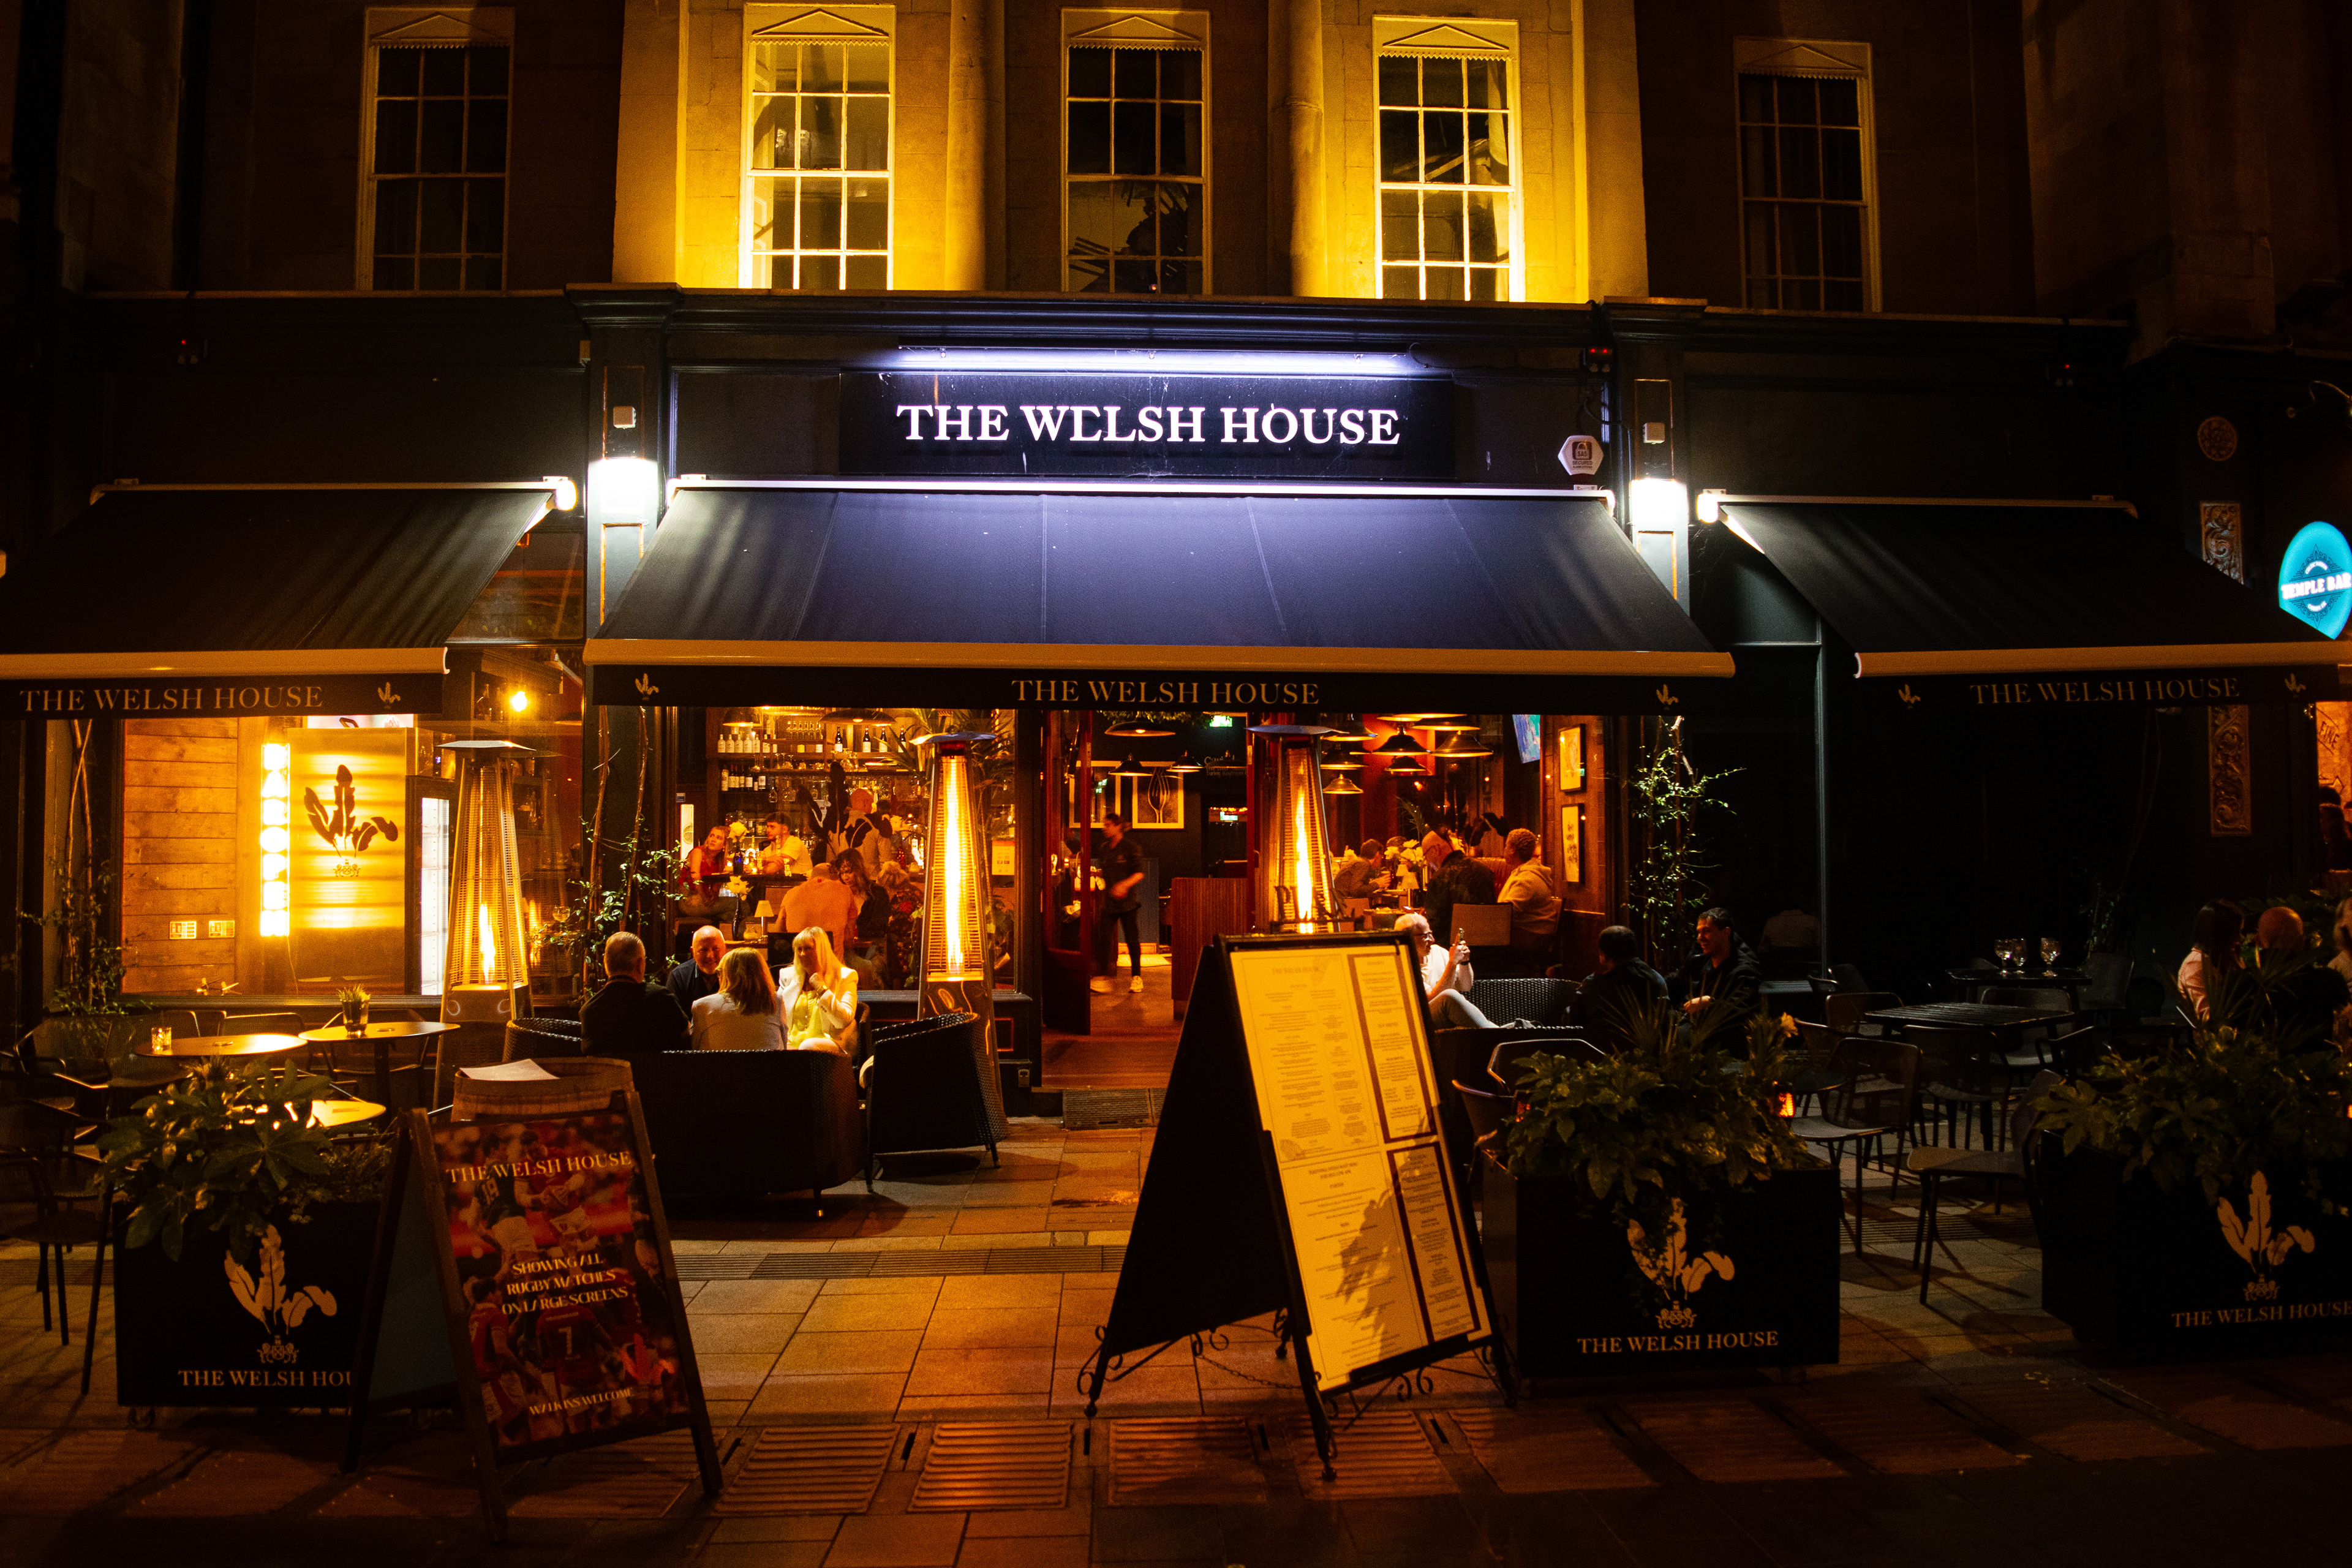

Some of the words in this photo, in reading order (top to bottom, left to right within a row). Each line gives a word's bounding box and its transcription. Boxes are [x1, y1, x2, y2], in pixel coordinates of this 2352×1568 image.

[896, 405, 1009, 441] THE
[1019, 405, 1205, 442] WELSH
[1220, 407, 1400, 445] HOUSE
[2281, 578, 2325, 600] TEMPLE
[2326, 572, 2351, 591] BAR
[19, 690, 85, 711] THE
[94, 688, 203, 710] WELSH
[214, 686, 323, 709] HOUSE
[1013, 680, 1079, 701] THE
[1085, 680, 1202, 703] WELSH
[1208, 682, 1321, 704] HOUSE
[1969, 683, 2031, 704] THE
[2037, 681, 2136, 702] WELSH
[2144, 677, 2240, 700] HOUSE
[446, 1166, 489, 1182] THE
[493, 1158, 561, 1177] WELSH
[567, 1151, 631, 1171] HOUSE
[512, 1257, 577, 1275] SHOWING
[507, 1278, 551, 1295] RUGBY
[553, 1270, 616, 1289] MATCHES
[502, 1302, 521, 1315] ON
[523, 1295, 568, 1312] LARGE
[569, 1286, 628, 1306] SCREENS
[2171, 1310, 2212, 1327] THE
[2216, 1306, 2283, 1324] WELSH
[2289, 1301, 2352, 1319] HOUSE
[1577, 1337, 1623, 1354] THE
[1627, 1335, 1700, 1352] WELSH
[1707, 1331, 1779, 1349] HOUSE
[178, 1370, 225, 1386] THE
[229, 1370, 304, 1387] WELSH
[582, 1387, 635, 1404] WELCOME
